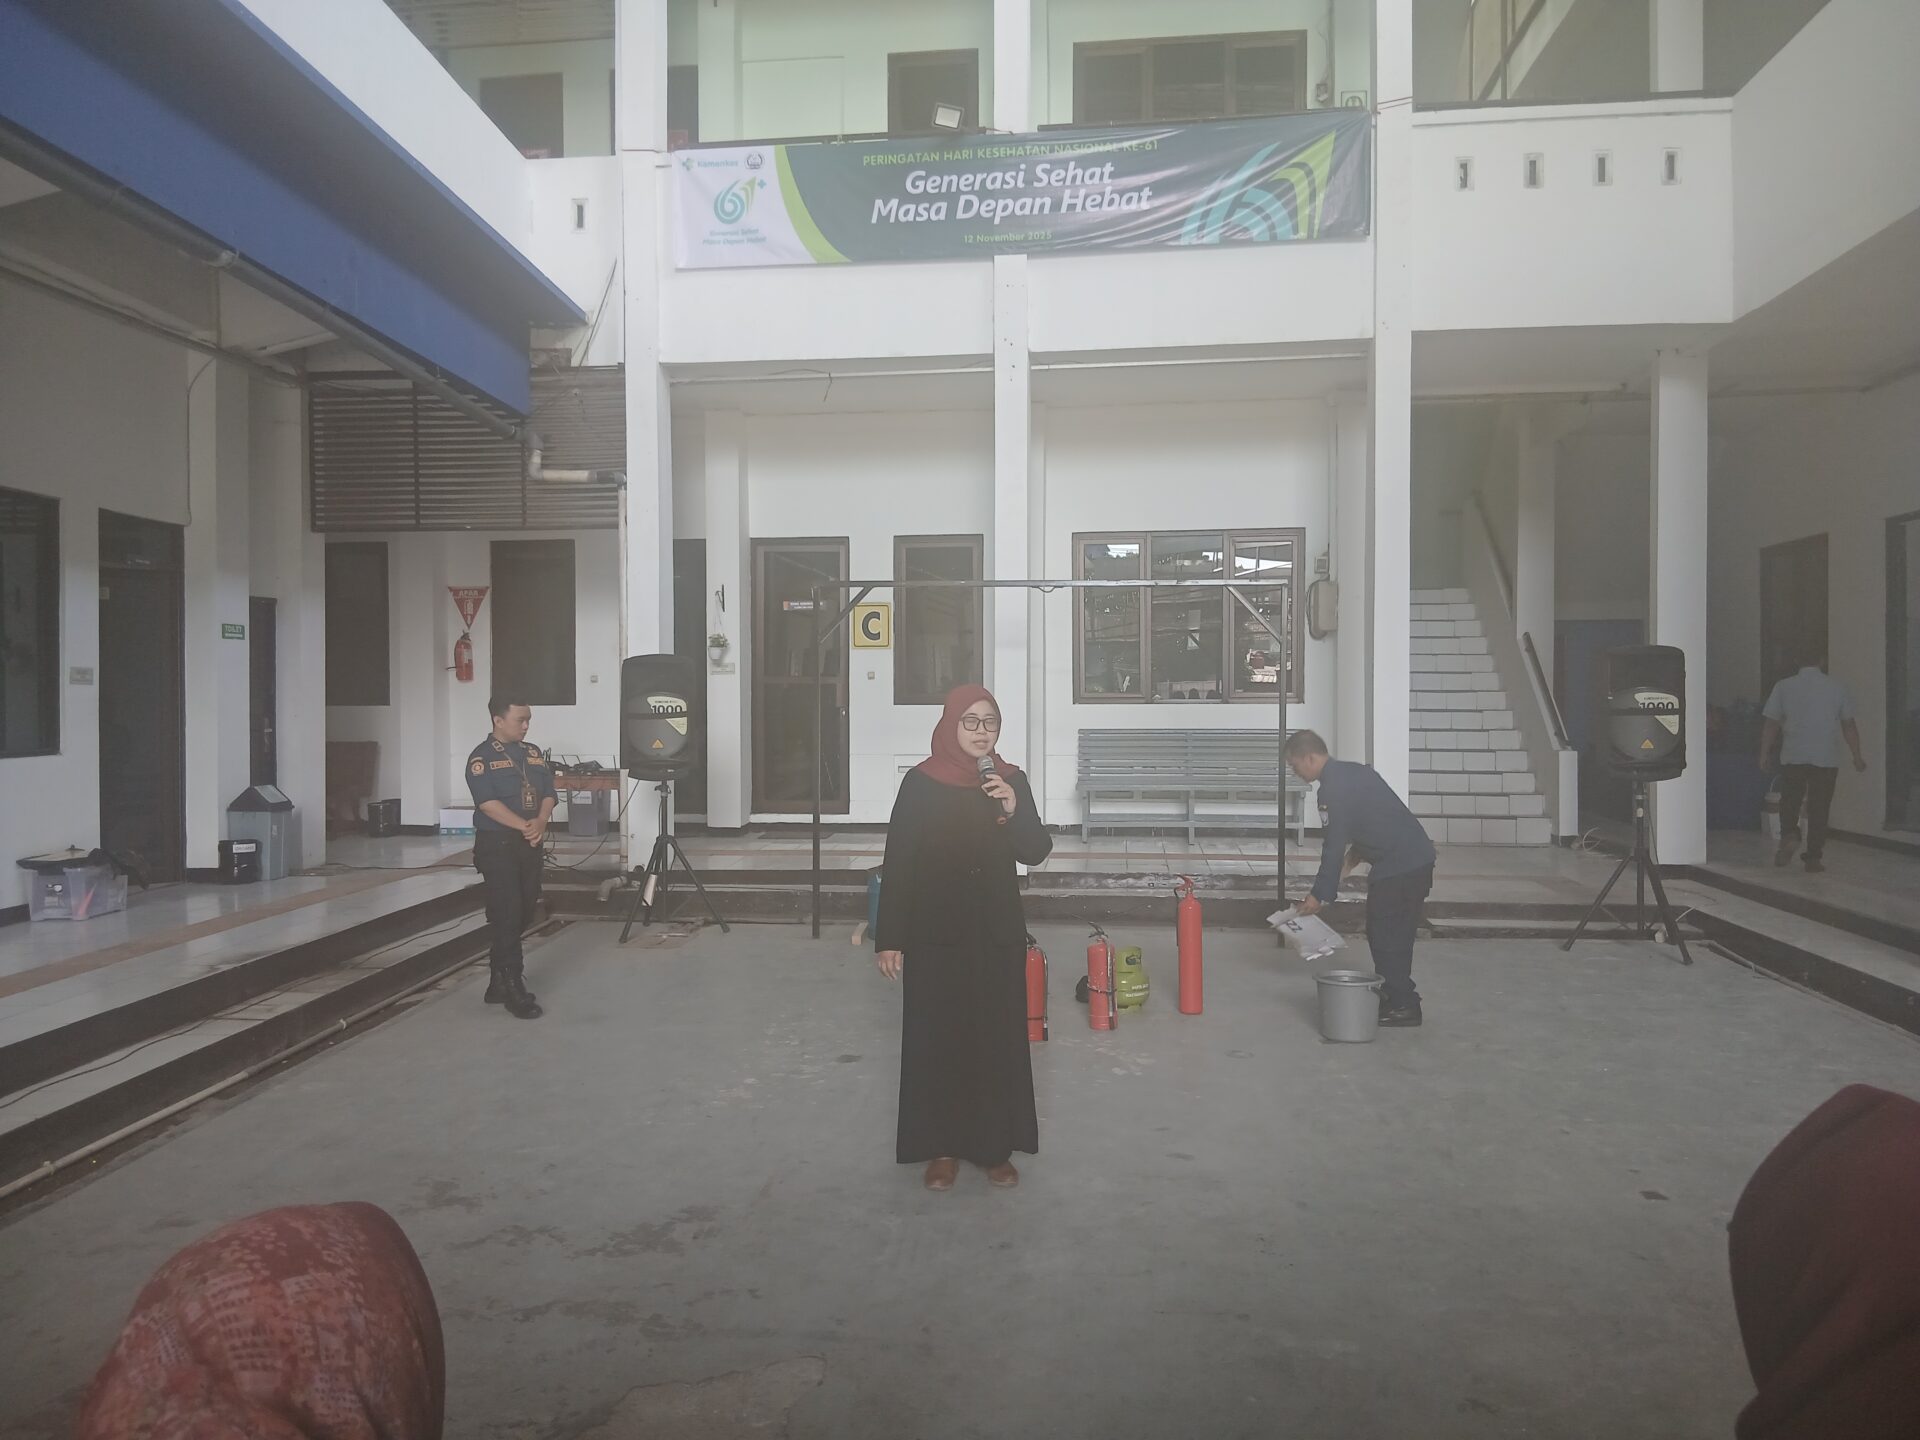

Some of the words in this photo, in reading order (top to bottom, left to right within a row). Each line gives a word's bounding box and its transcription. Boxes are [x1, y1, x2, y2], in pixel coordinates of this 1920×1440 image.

[863, 151, 940, 166] PERINGATAN
[943, 148, 973, 161] HARI
[977, 143, 1050, 159] KESEHATAN
[1054, 140, 1118, 154] NASIONAL
[1123, 139, 1158, 152] KE-61
[905, 163, 1026, 195] Generasi
[1033, 161, 1115, 188] Sehat
[871, 198, 948, 224] Masa
[956, 194, 1052, 225] Depan
[1060, 186, 1153, 214] Hebat
[964, 235, 974, 243] 12
[976, 233, 1025, 243] November
[1028, 231, 1052, 241] 2025
[861, 611, 880, 641] C
